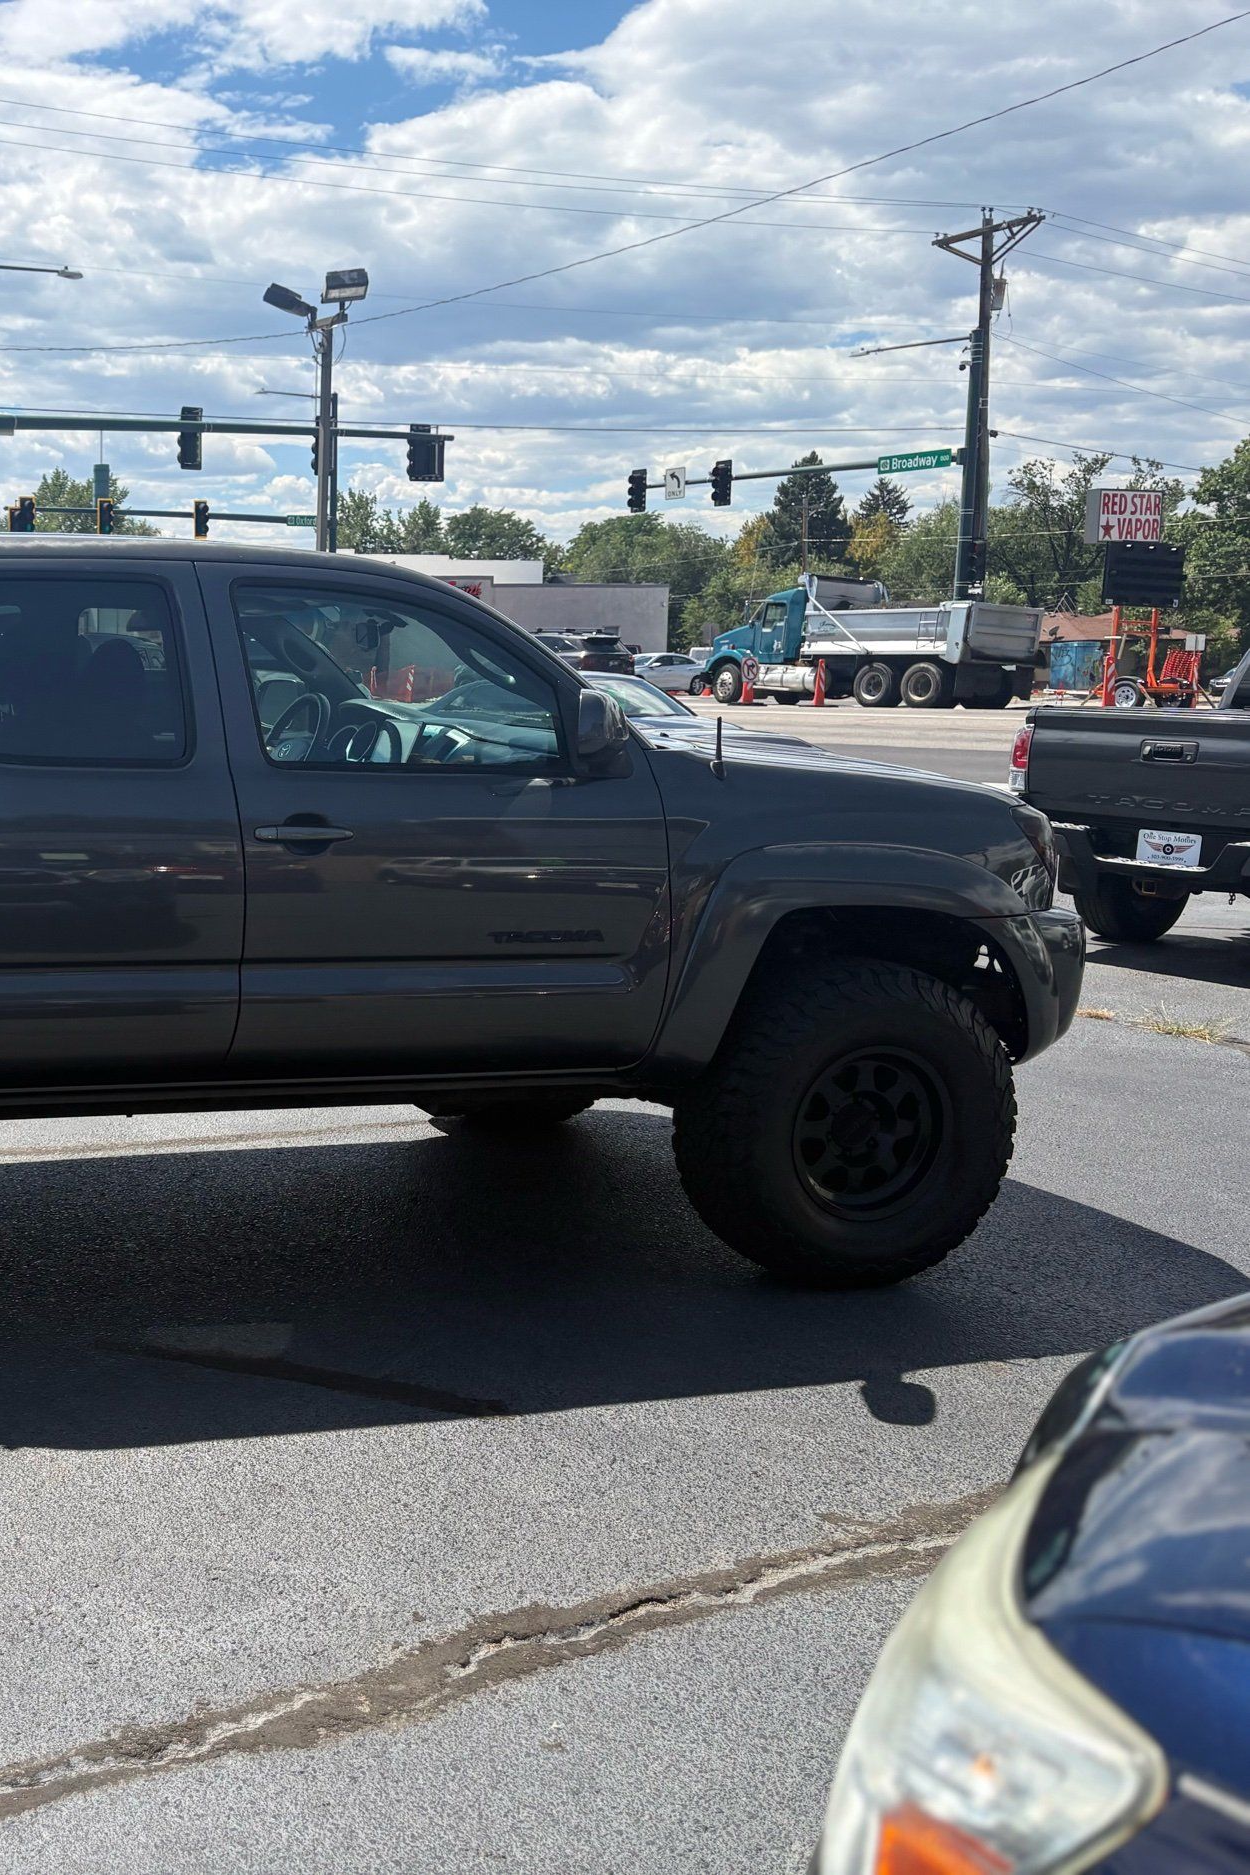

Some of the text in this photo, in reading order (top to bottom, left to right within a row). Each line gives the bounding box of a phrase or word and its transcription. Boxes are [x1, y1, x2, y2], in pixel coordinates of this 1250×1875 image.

[891, 455, 938, 470] Broadway
[667, 490, 683, 498] ONLY
[1102, 493, 1161, 516] RED STAR
[296, 516, 317, 525] Oxford
[1117, 517, 1160, 540] VAPOR
[1143, 832, 1197, 844] One Stop Motors
